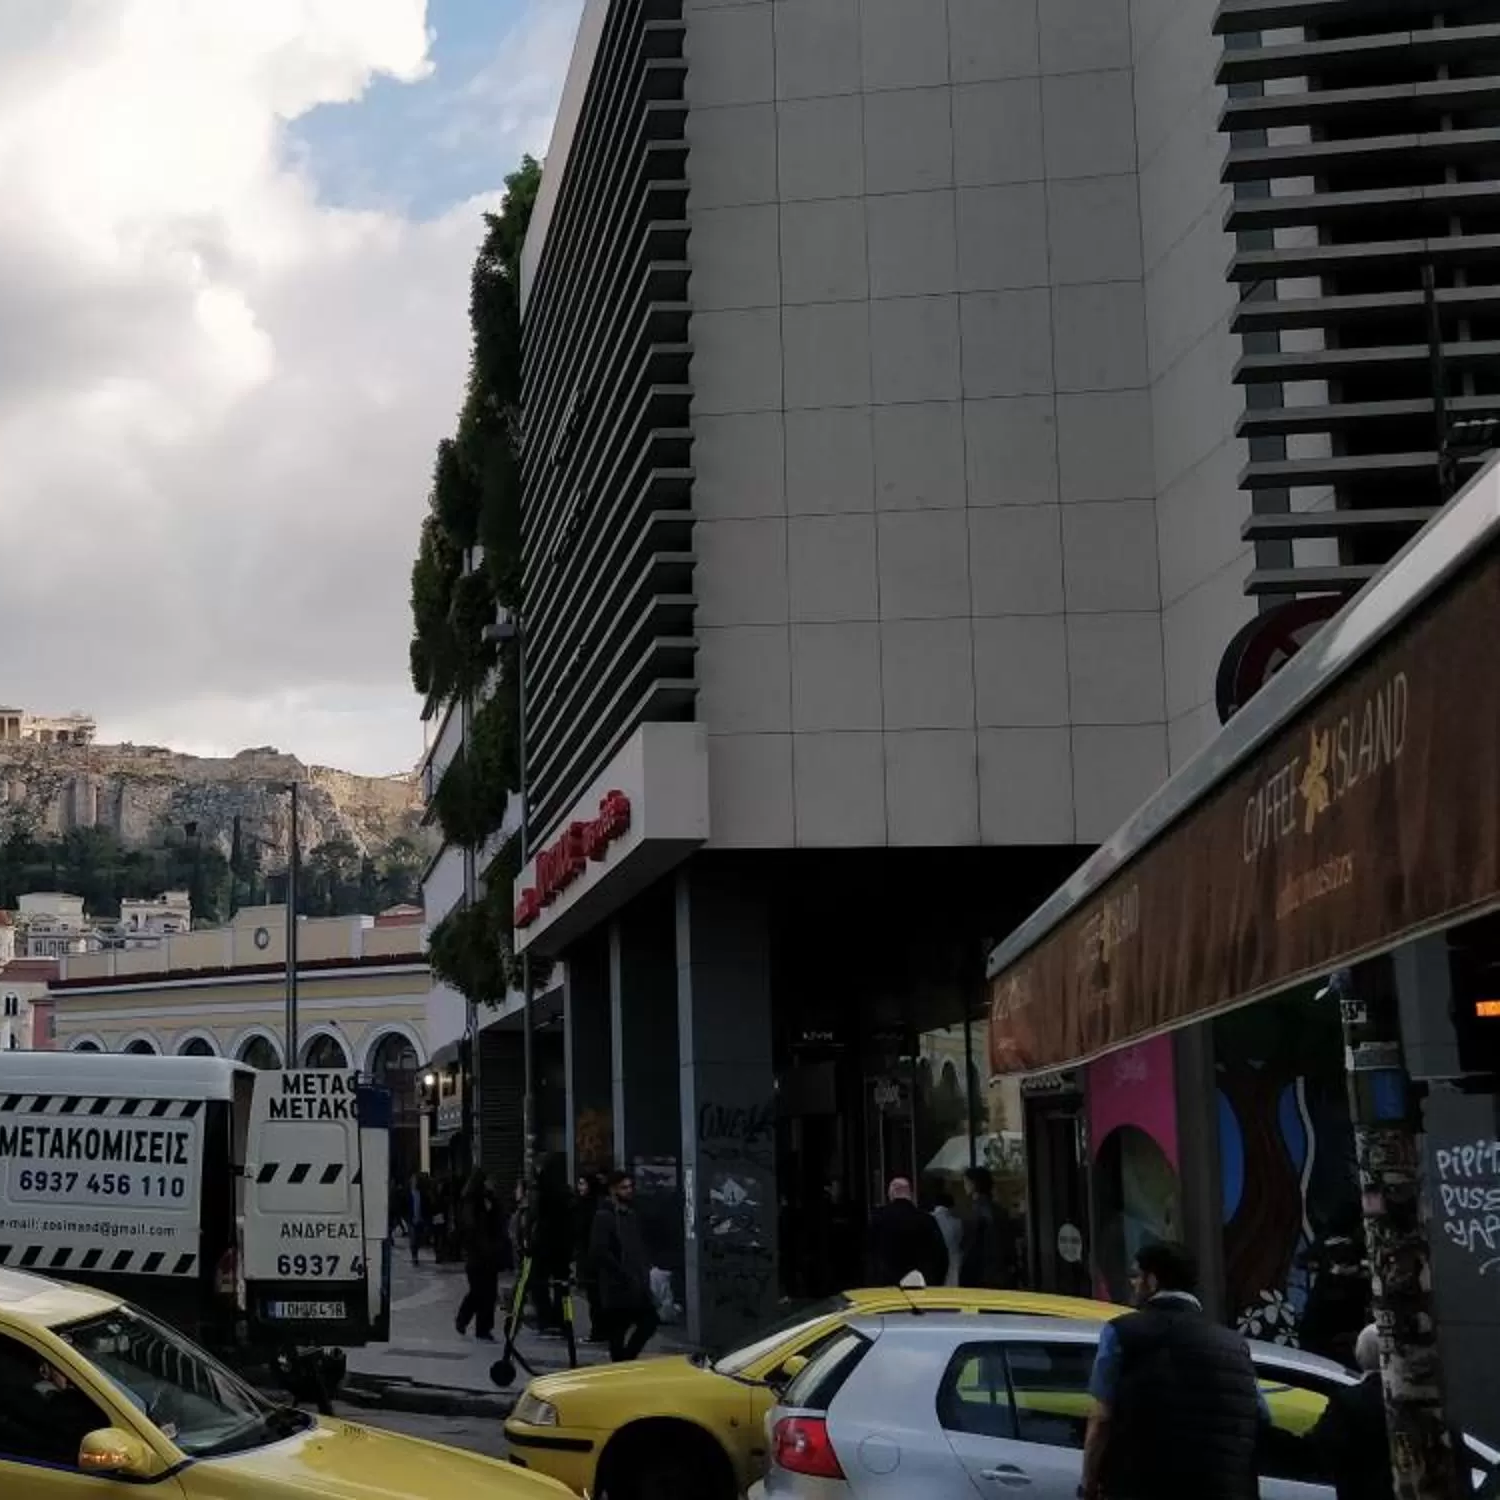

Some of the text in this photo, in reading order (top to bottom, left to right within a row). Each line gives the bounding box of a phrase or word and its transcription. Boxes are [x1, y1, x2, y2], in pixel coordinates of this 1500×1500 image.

[1242, 671, 1409, 864] COFFEE ISLAND
[19, 1169, 185, 1199] 6937 456 110
[279, 1223, 360, 1239] ΑΝΔΡΕΑΣ
[277, 1254, 341, 1277] 6937
